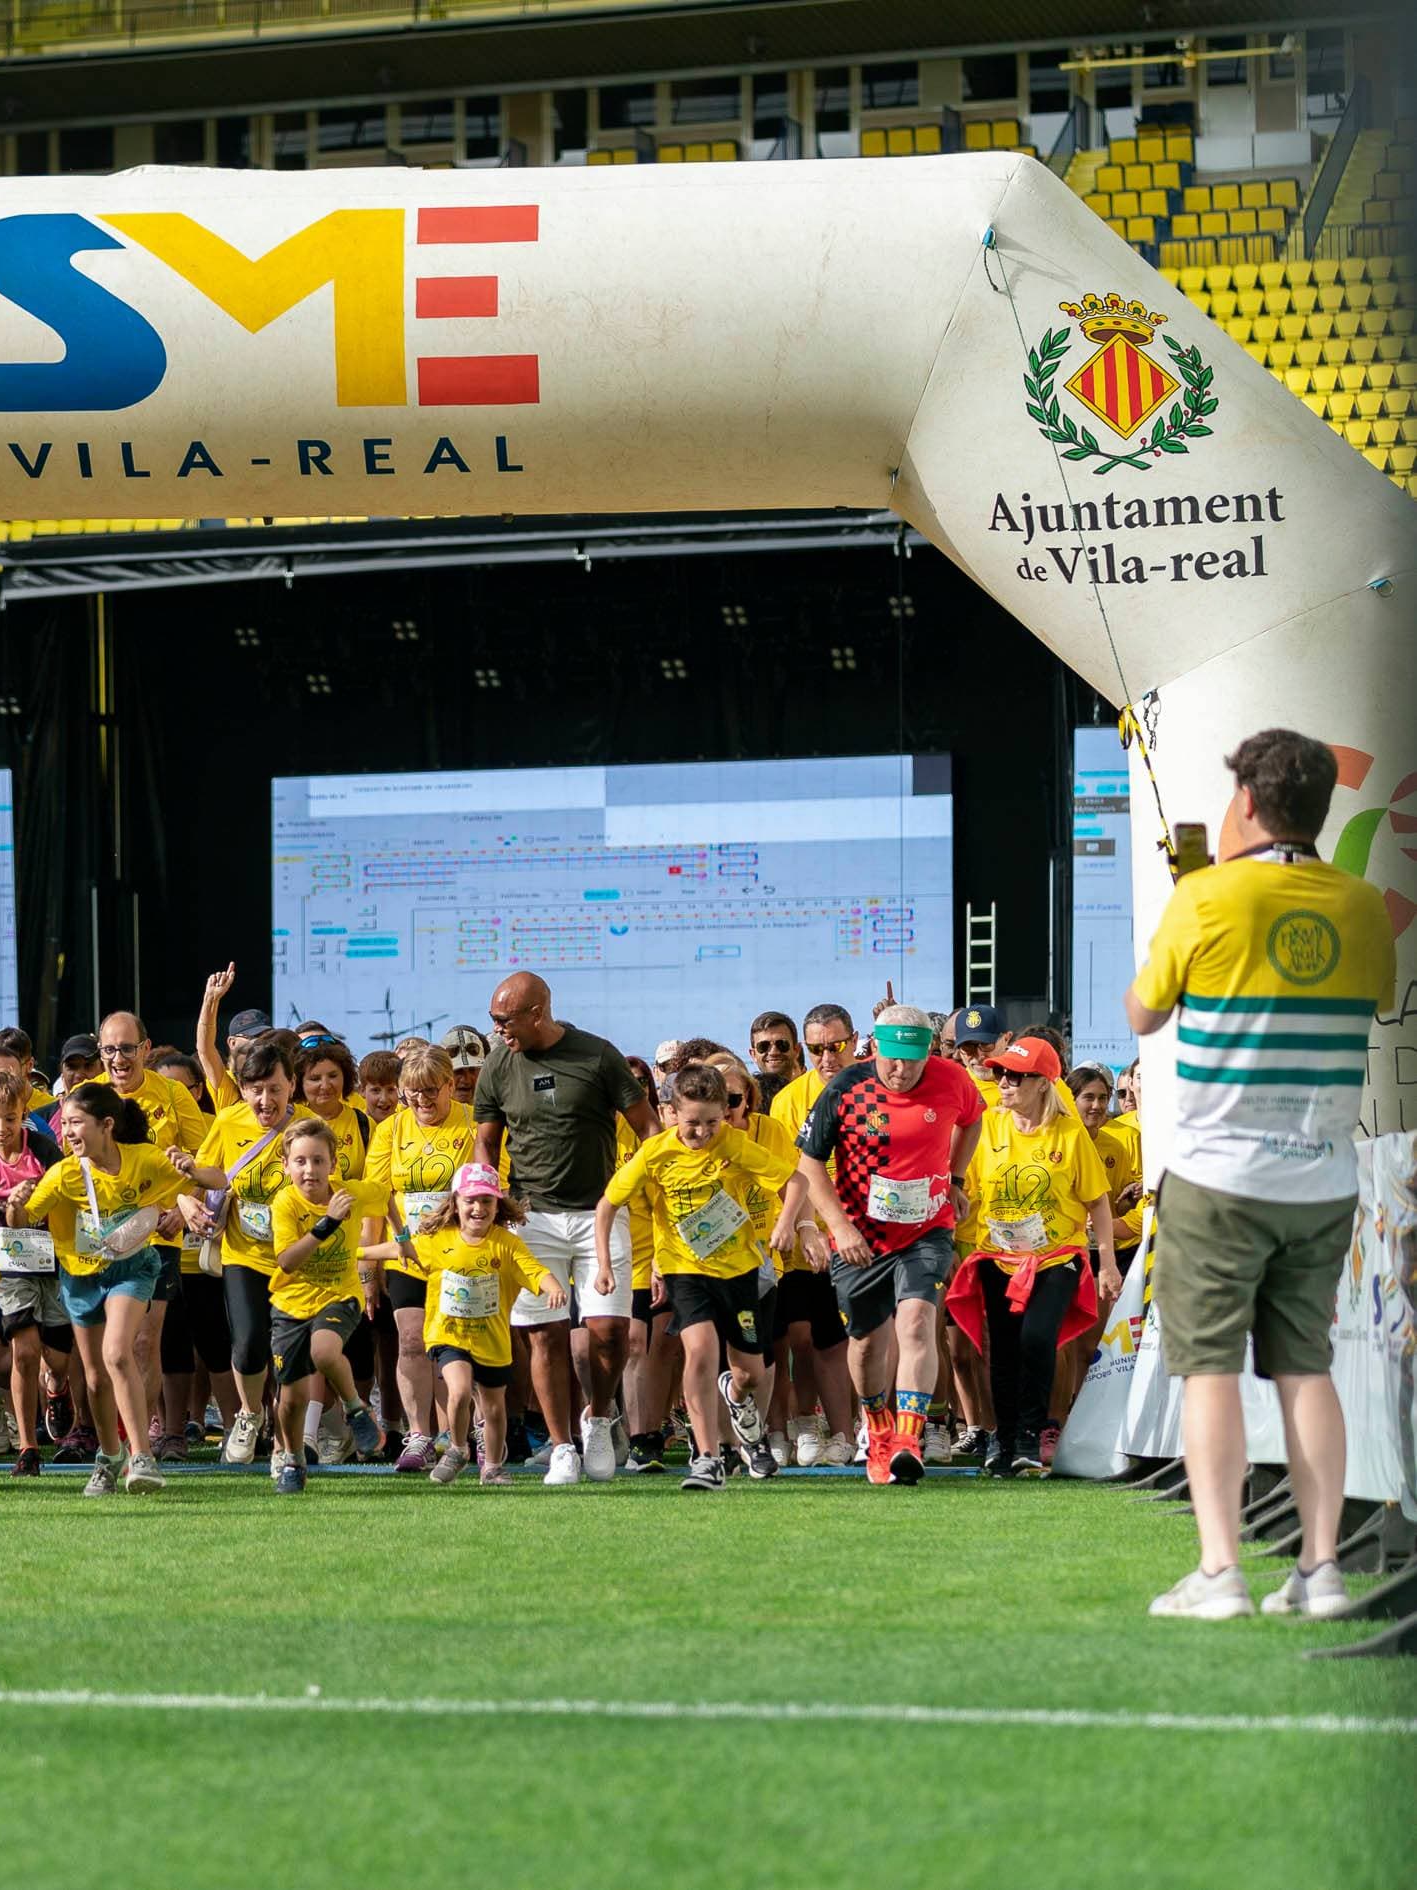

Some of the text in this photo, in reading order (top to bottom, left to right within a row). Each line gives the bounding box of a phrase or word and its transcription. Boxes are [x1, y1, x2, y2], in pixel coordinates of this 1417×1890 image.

[8, 436, 524, 479] VILA-REAL
[987, 486, 1286, 546] Ajuntament
[1016, 534, 1269, 585] de Vila-real
[996, 1164, 1051, 1211] 12
